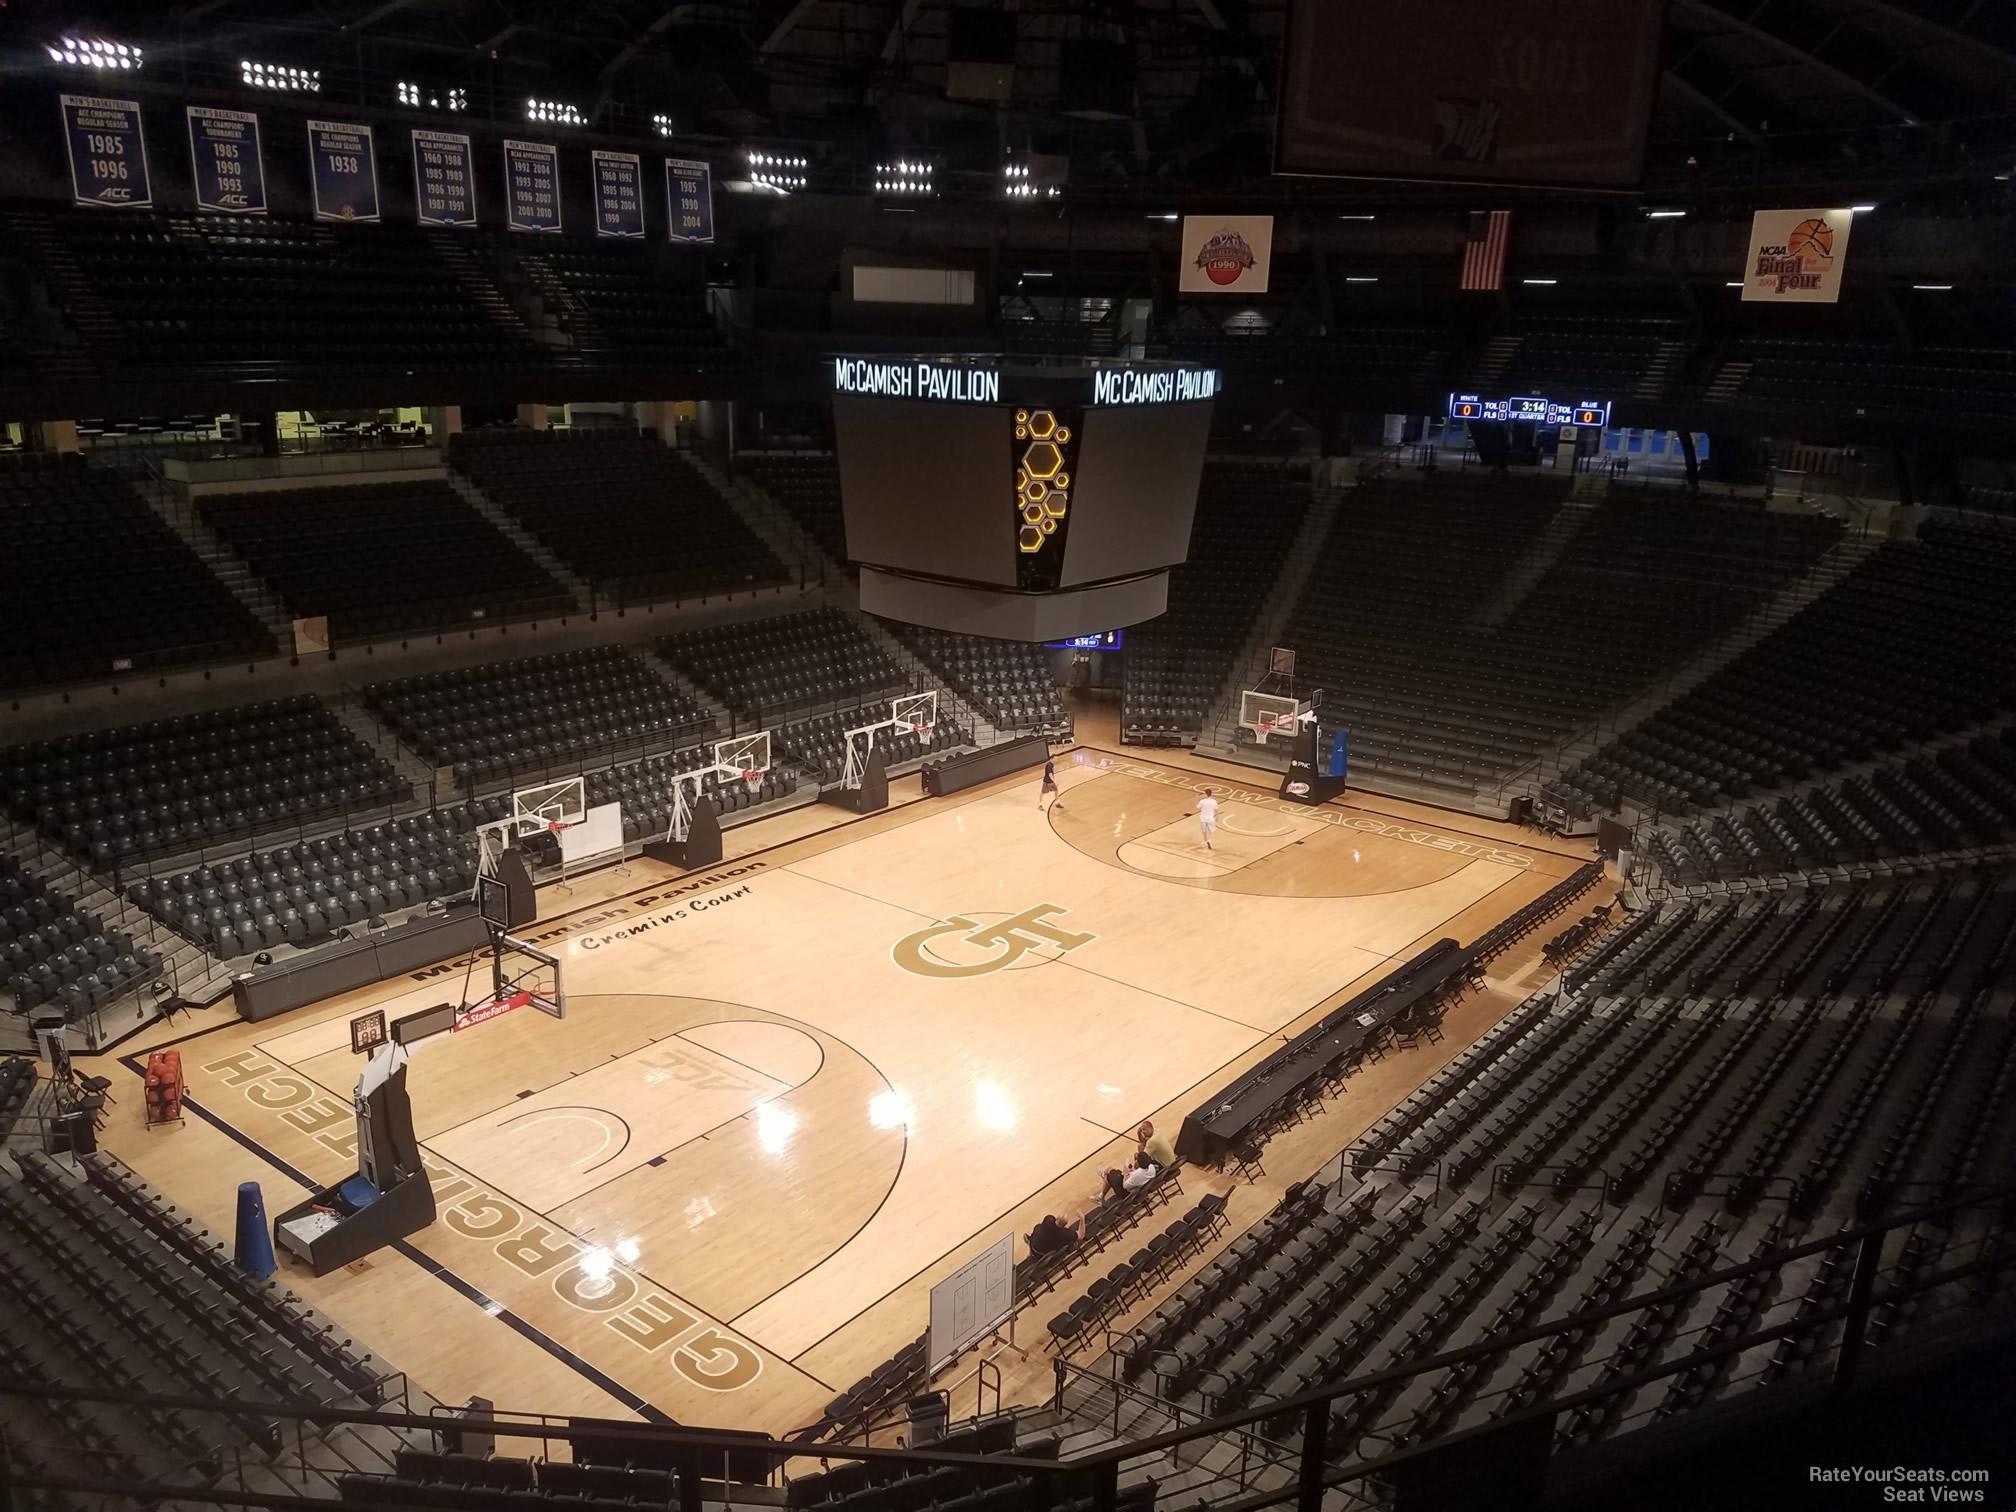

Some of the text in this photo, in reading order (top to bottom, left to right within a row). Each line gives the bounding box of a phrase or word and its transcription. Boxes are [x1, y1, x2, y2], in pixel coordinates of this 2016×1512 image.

[88, 134, 124, 154] 1985
[214, 144, 238, 158] 1985
[424, 152, 442, 164] 1960
[92, 160, 128, 180] 1996
[216, 160, 240, 174] 1990
[329, 156, 358, 174] 1938
[514, 162, 550, 175] 1992 2004
[426, 168, 442, 180] 1985
[218, 178, 242, 192] 1993
[448, 185, 464, 196] 1990
[680, 180, 696, 193] 1985
[99, 188, 132, 198] ACC
[219, 194, 248, 204] ACC
[536, 193, 552, 204] 2007
[428, 198, 464, 212] 1987 1991
[681, 198, 698, 210] 1990
[518, 206, 552, 218] 2001 2010
[682, 216, 701, 228] 2004
[1758, 246, 1787, 256] NCAA
[1213, 261, 1236, 269] 1990
[1755, 256, 1804, 277] Final
[1775, 274, 1822, 294] Four
[918, 364, 999, 402] PAVILION
[1176, 369, 1216, 400] PAVILION
[1464, 405, 1470, 416] 0
[1522, 401, 1545, 412] 3:14
[1584, 412, 1592, 422] 0
[1096, 758, 1534, 868] YELLOW JACKETS
[634, 861, 768, 910] Pavilion
[580, 884, 754, 951] Cremins Court
[200, 1050, 359, 1160] TECH
